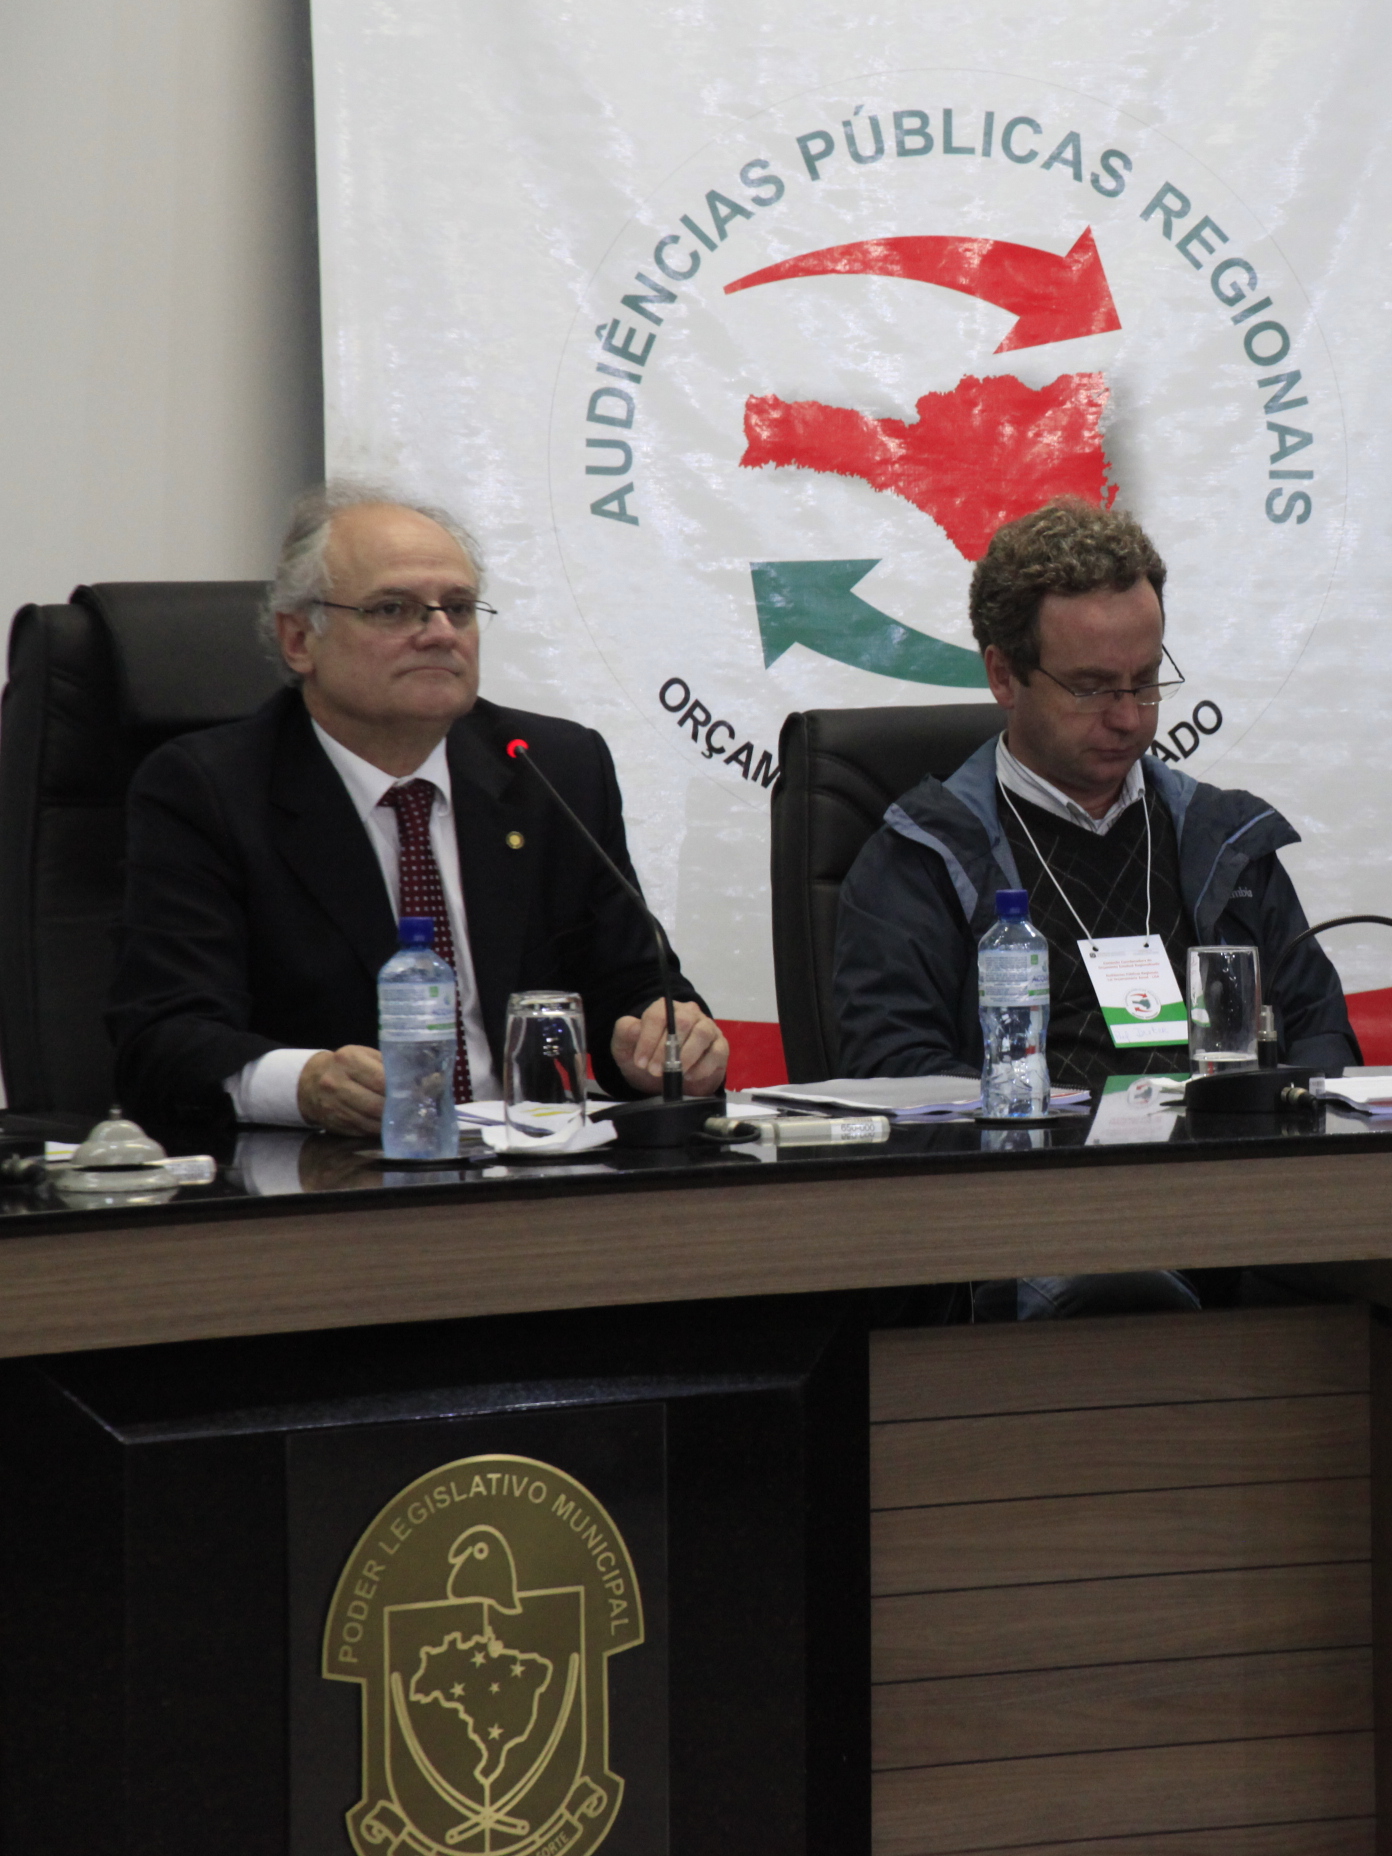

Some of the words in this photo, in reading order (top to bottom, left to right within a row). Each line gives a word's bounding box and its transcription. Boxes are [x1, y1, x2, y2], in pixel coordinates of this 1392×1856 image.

[584, 158, 786, 527] AUDIÊNCIAS
[796, 104, 1133, 199] PÚBLICAS
[1140, 181, 1315, 526] REGIONAIS
[658, 677, 781, 789] ORÇAM
[1151, 699, 1223, 763] ADO
[339, 1559, 386, 1663] PODER
[379, 1473, 547, 1555] LEGISLATIVO
[551, 1494, 630, 1636] MUNICIPAL
